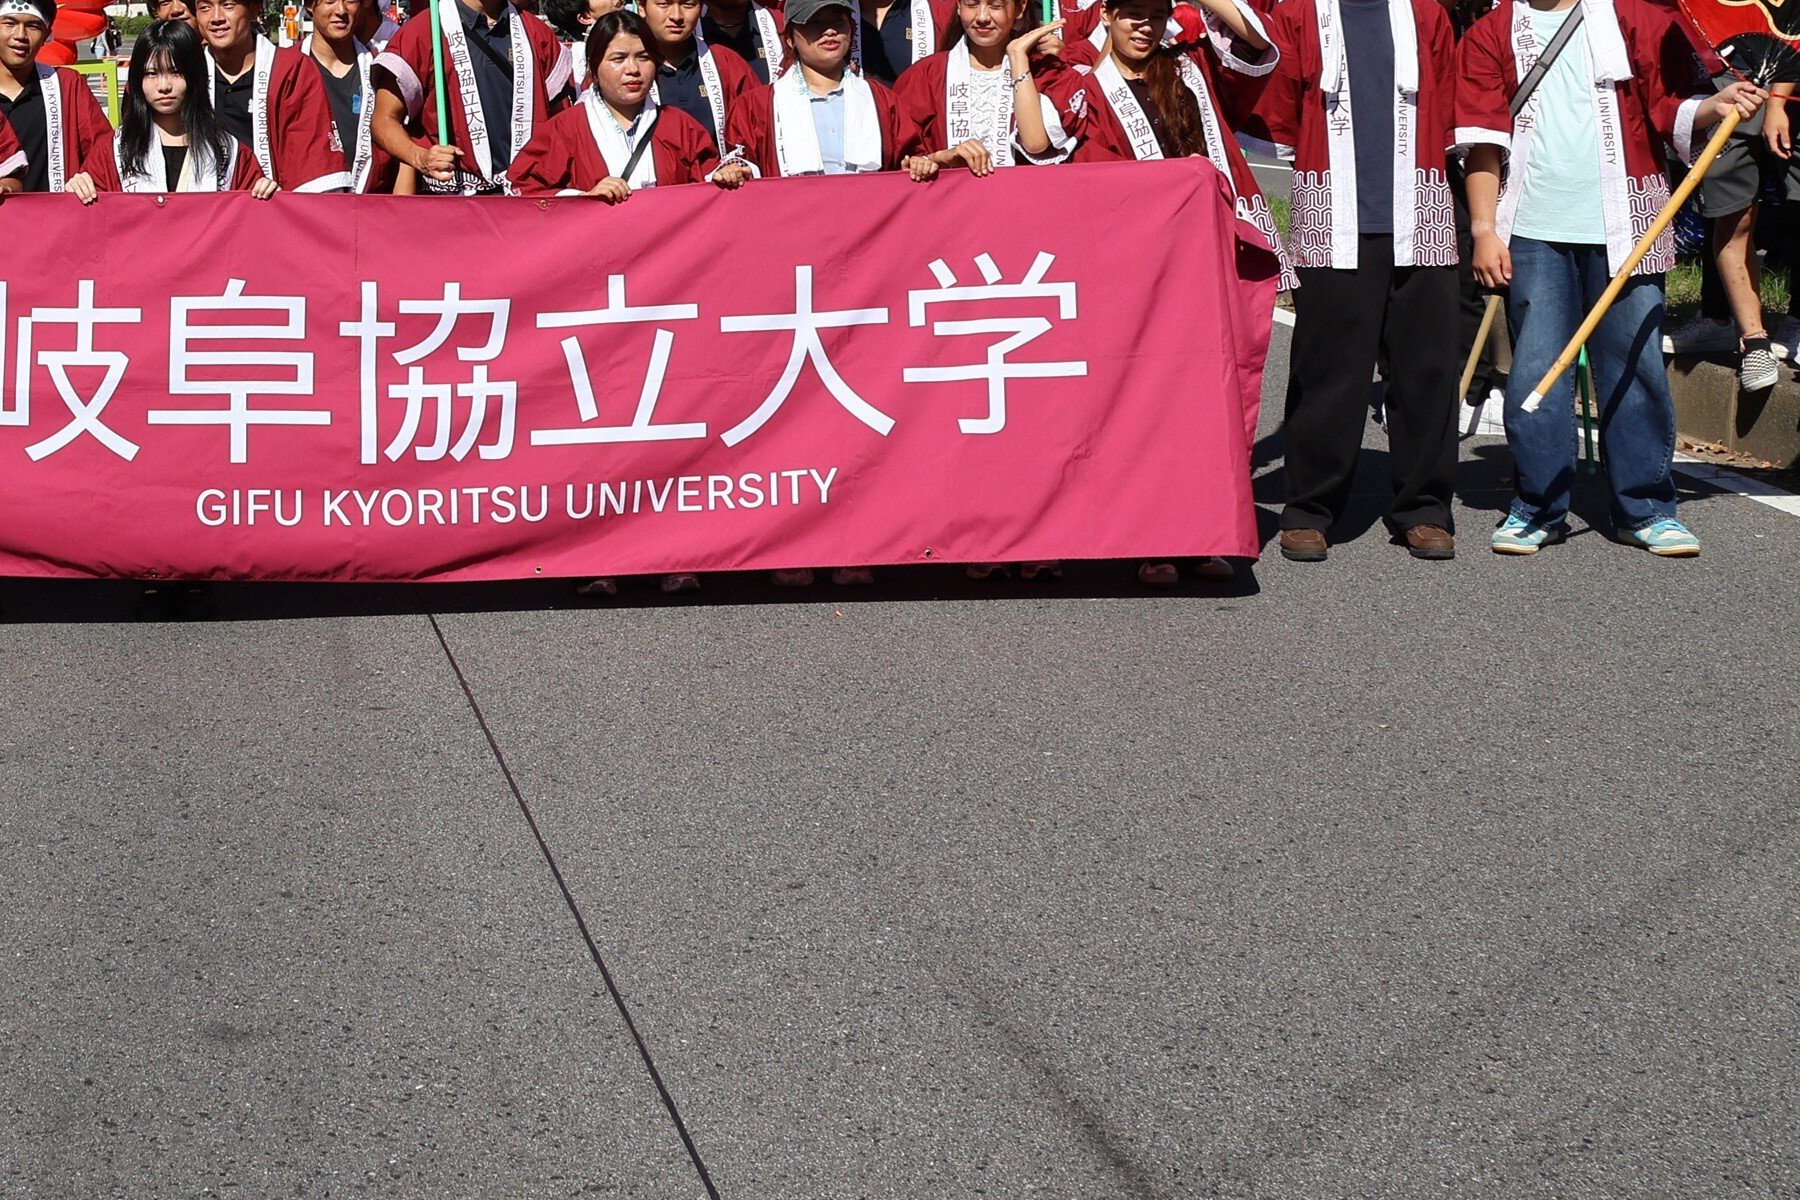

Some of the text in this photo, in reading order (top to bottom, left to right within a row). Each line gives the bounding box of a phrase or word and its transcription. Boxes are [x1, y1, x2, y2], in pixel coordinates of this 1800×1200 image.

[258, 71, 268, 97] GIFU
[446, 29, 487, 146] 岐阜協立大学
[514, 41, 527, 94] KYORITSU
[47, 92, 60, 141] KYORITSU
[258, 99, 270, 151] KYORITSU
[997, 94, 1012, 150] KYORITSU
[1597, 97, 1618, 166] UNIVERSITY
[195, 467, 840, 527] GIFU KYORITSU UNIVERSITY
